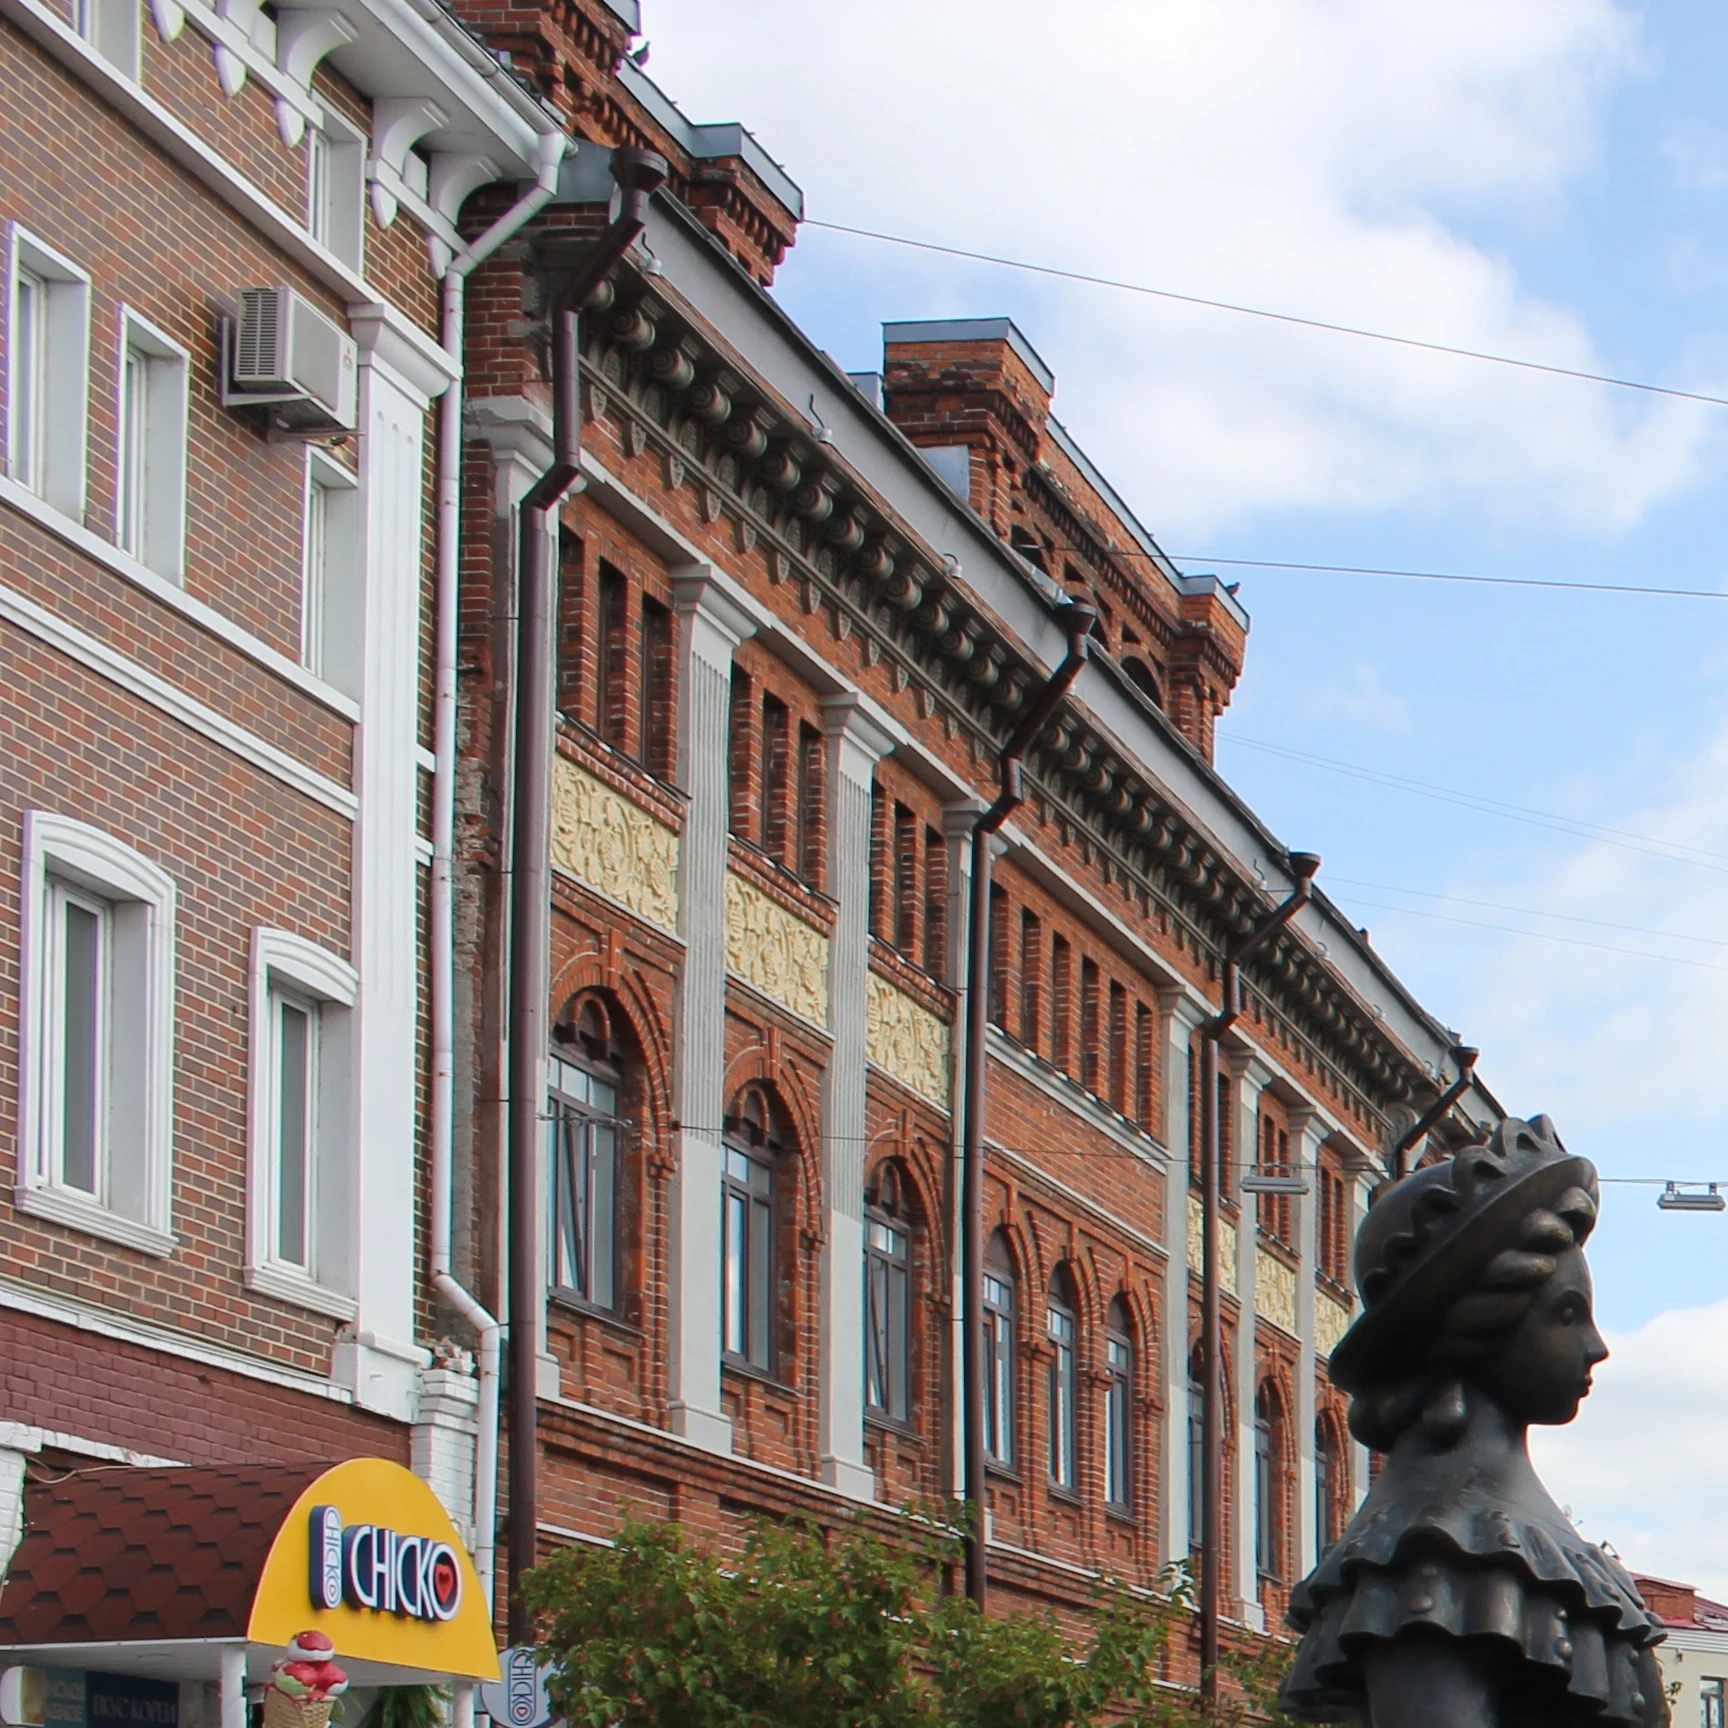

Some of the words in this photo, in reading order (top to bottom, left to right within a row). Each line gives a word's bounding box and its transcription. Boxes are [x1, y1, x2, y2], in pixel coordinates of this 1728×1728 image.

[326, 1509, 340, 1604] CHICKO
[350, 1526, 462, 1621] CHICKO
[512, 1652, 533, 1722] CHICKO
